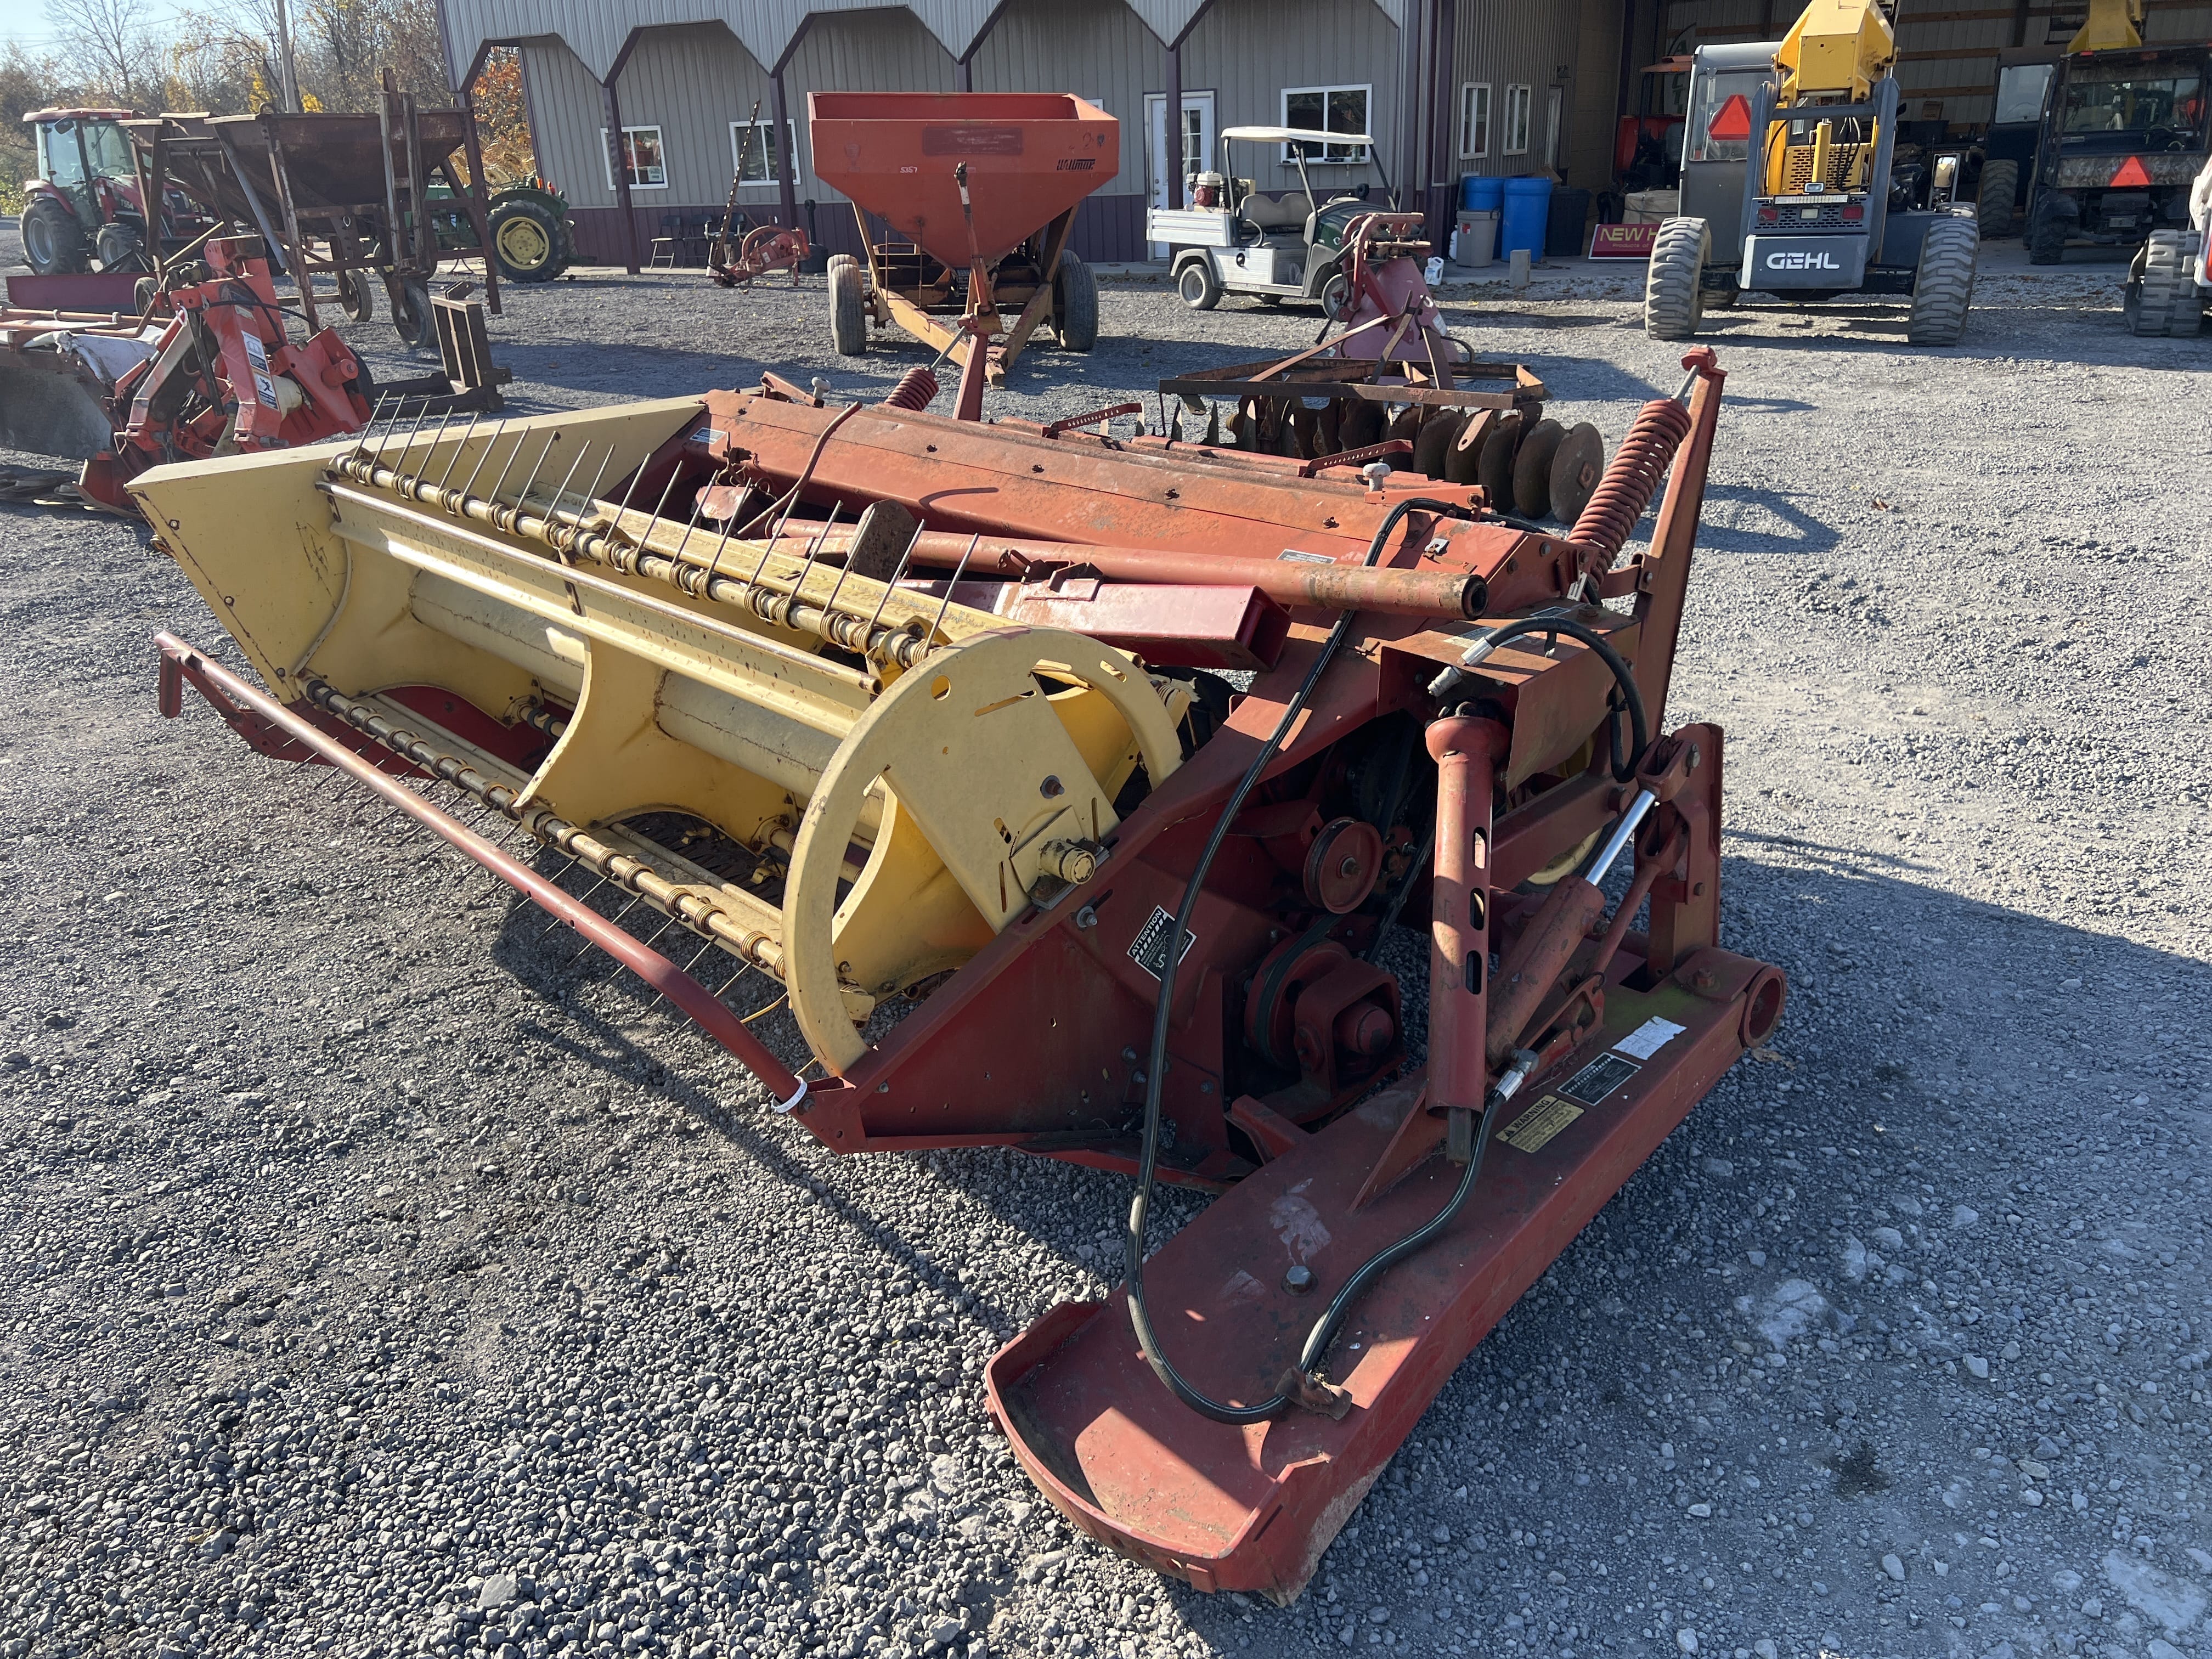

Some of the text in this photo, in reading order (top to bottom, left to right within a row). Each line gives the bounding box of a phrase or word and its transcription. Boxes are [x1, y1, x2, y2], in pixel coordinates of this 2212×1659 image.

[1600, 228, 1644, 241] NEW
[1767, 252, 1839, 269] GEHL
[1132, 911, 1162, 956] ATTENTION
[1512, 1099, 1551, 1129] WARNING
